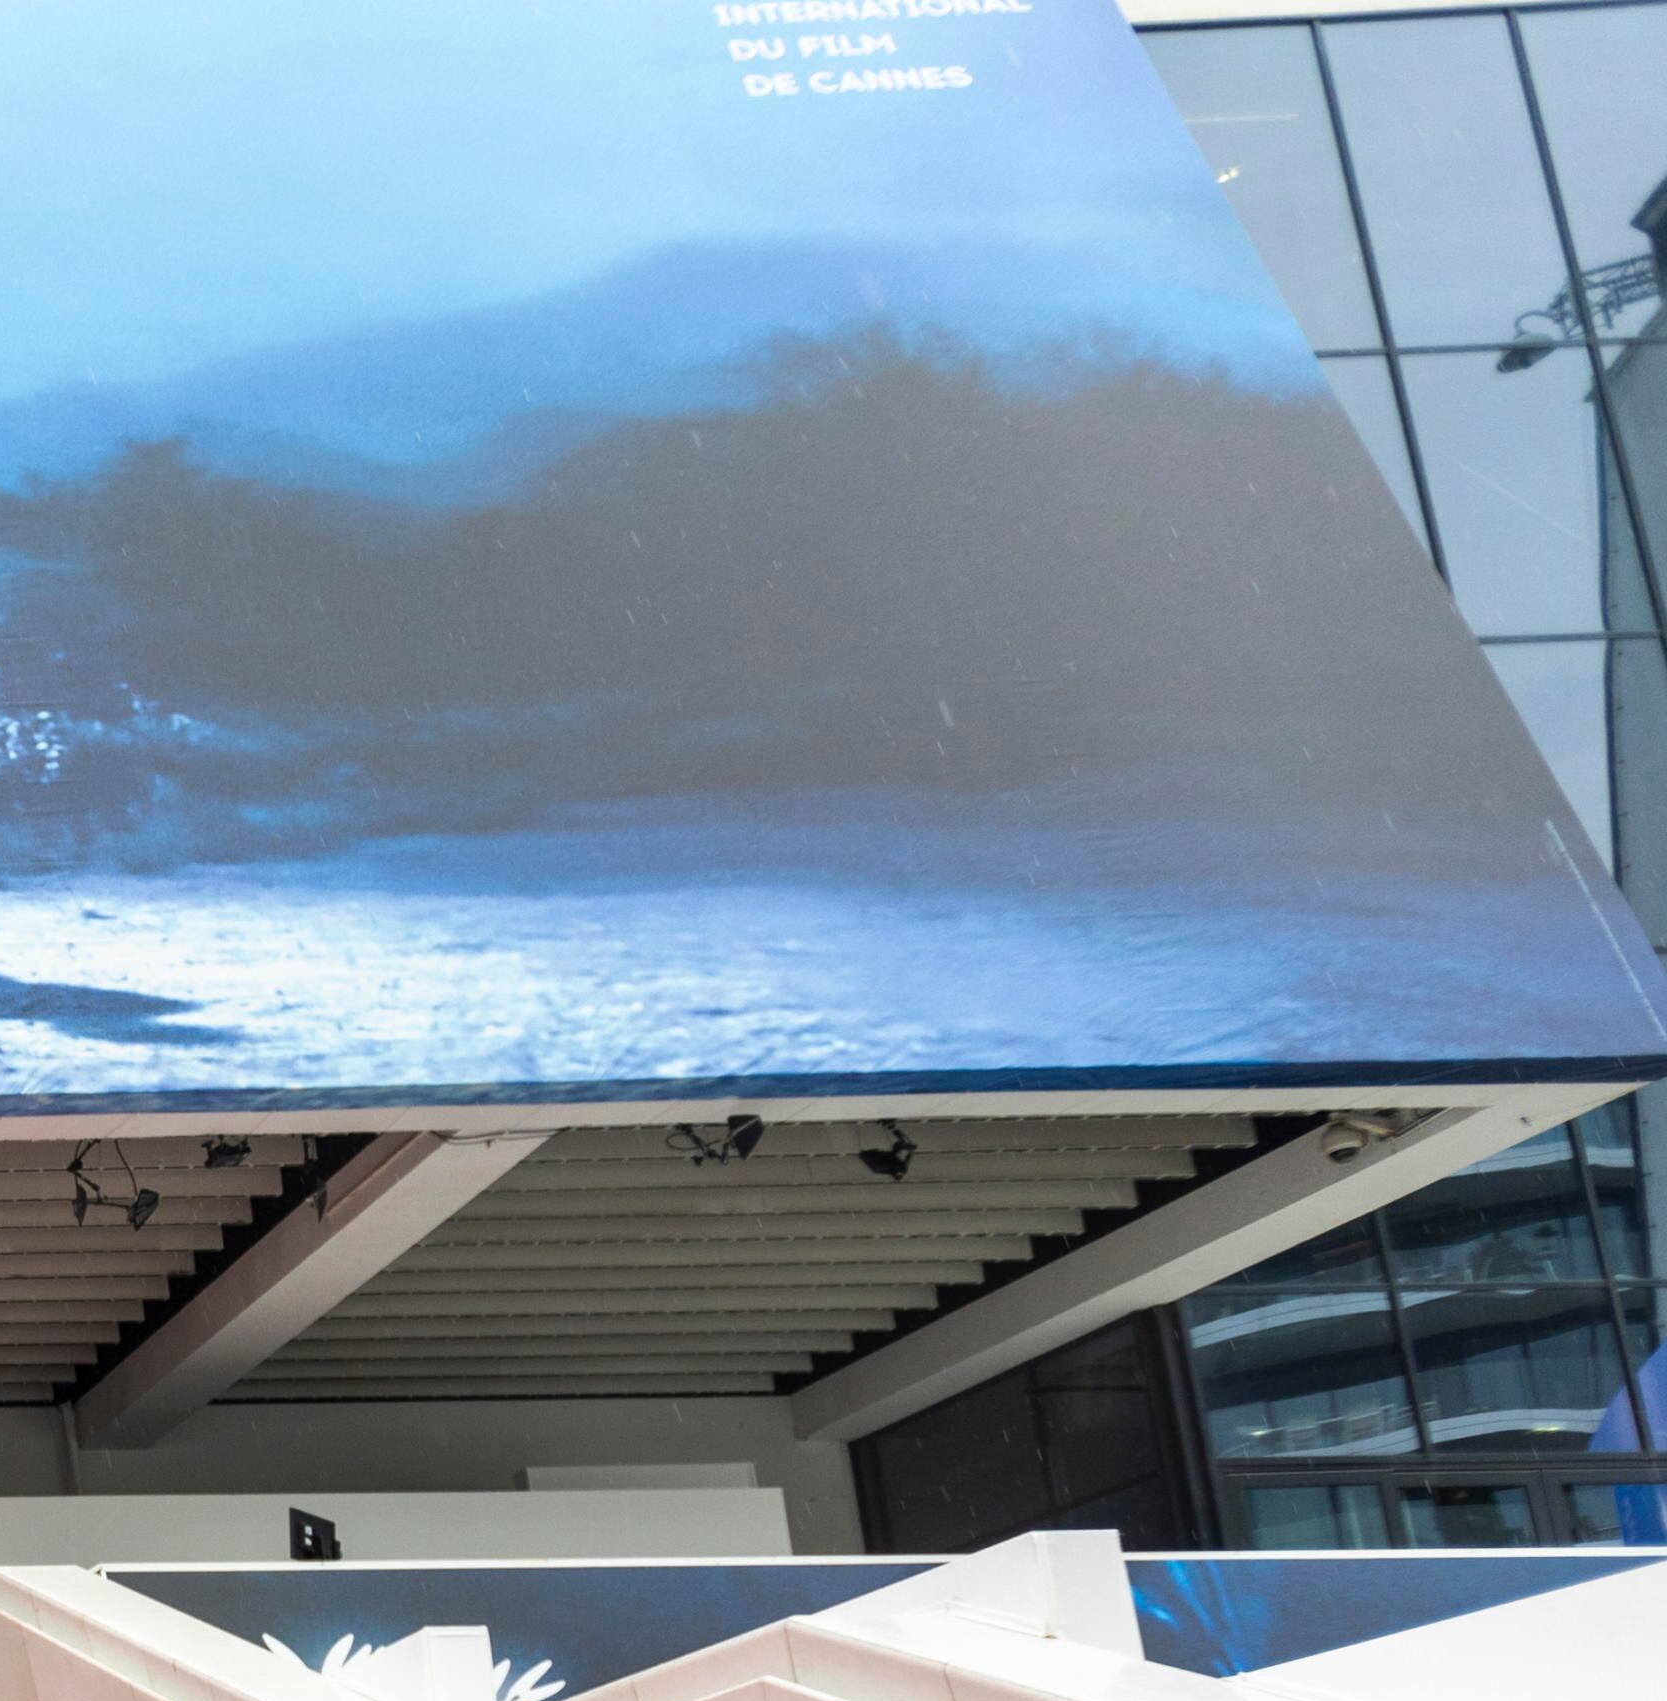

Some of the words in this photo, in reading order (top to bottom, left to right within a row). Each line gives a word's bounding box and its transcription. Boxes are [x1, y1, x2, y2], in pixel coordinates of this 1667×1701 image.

[727, 37, 786, 61] DU
[797, 32, 897, 58] FILM
[742, 72, 800, 97] DE
[808, 65, 974, 94] CANNES
